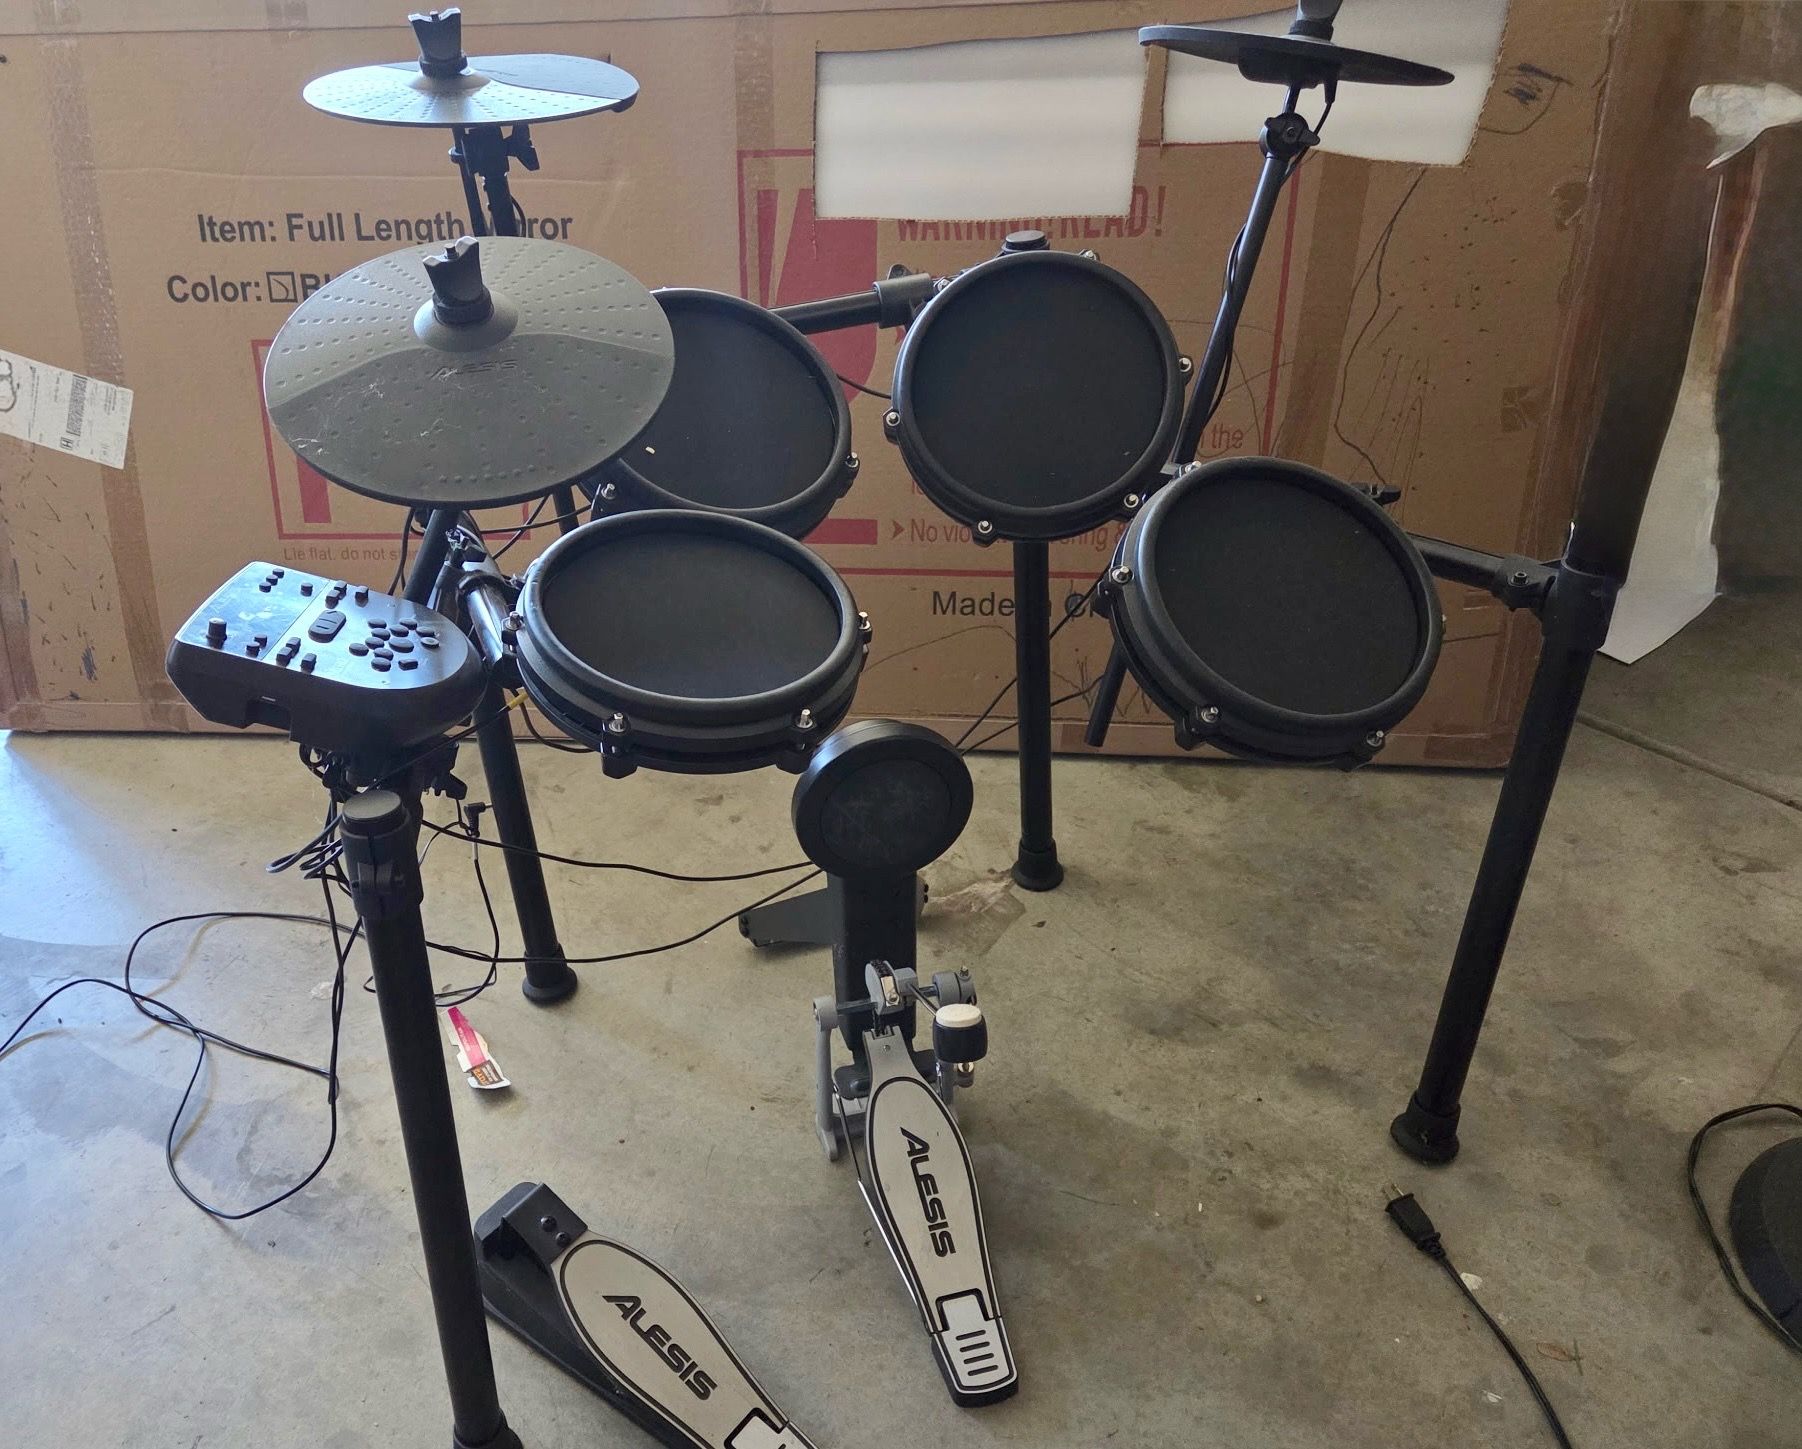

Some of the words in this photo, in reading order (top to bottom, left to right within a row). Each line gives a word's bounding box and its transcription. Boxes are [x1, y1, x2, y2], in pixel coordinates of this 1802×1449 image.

[197, 212, 277, 243] Item:
[286, 211, 346, 243] Full
[354, 211, 465, 245] Length
[167, 273, 263, 303] Color:
[1210, 422, 1244, 449] the
[910, 518, 939, 543] No
[283, 547, 306, 561] Lie
[340, 547, 360, 561] do
[364, 548, 387, 561] not
[931, 590, 1015, 617] Made
[900, 1126, 957, 1258] ALESIS
[602, 1295, 718, 1401] ALESIS
